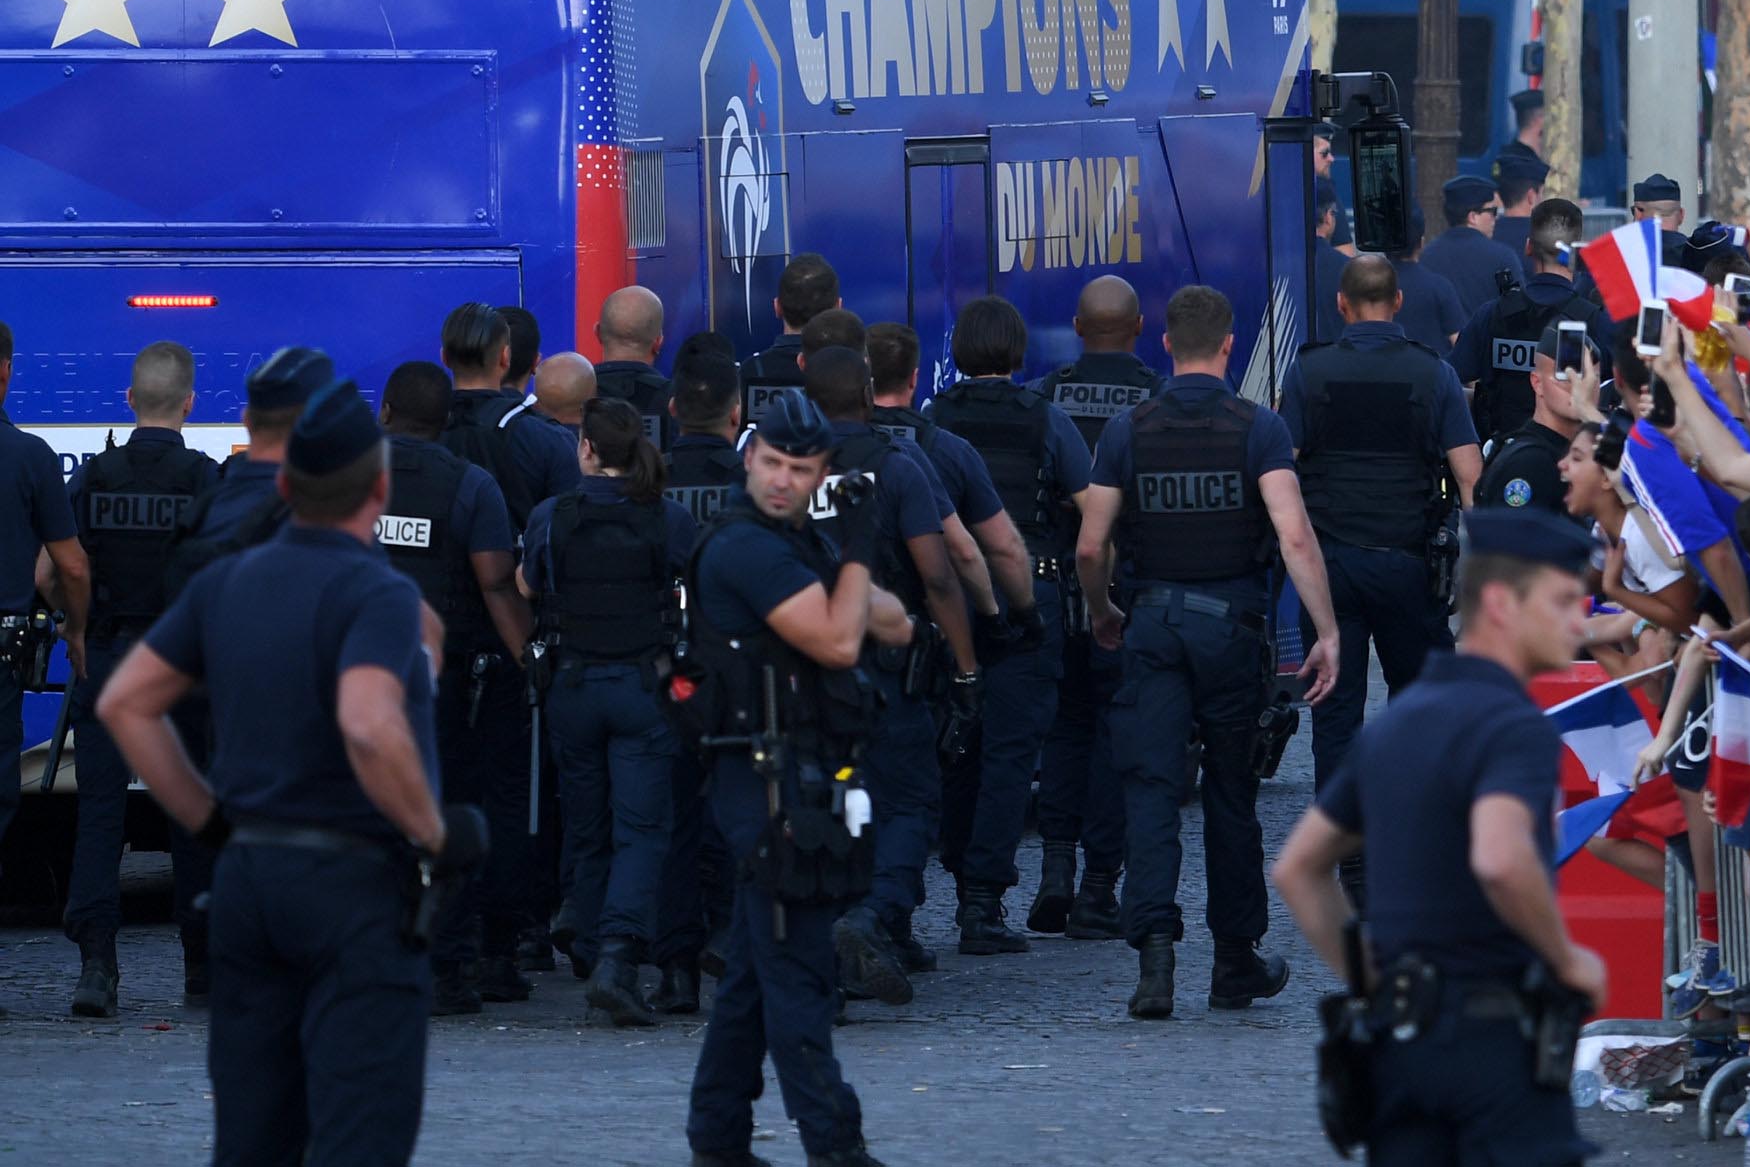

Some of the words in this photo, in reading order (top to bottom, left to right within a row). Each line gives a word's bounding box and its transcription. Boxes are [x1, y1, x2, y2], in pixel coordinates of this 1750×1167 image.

[1273, 16, 1288, 34] PARIS
[997, 162, 1036, 272] DU
[1042, 156, 1142, 268] MONDE
[1497, 345, 1536, 367] POL
[1058, 385, 1141, 406] POLICE
[1143, 473, 1240, 509] POLICE
[96, 495, 188, 527] POLICE
